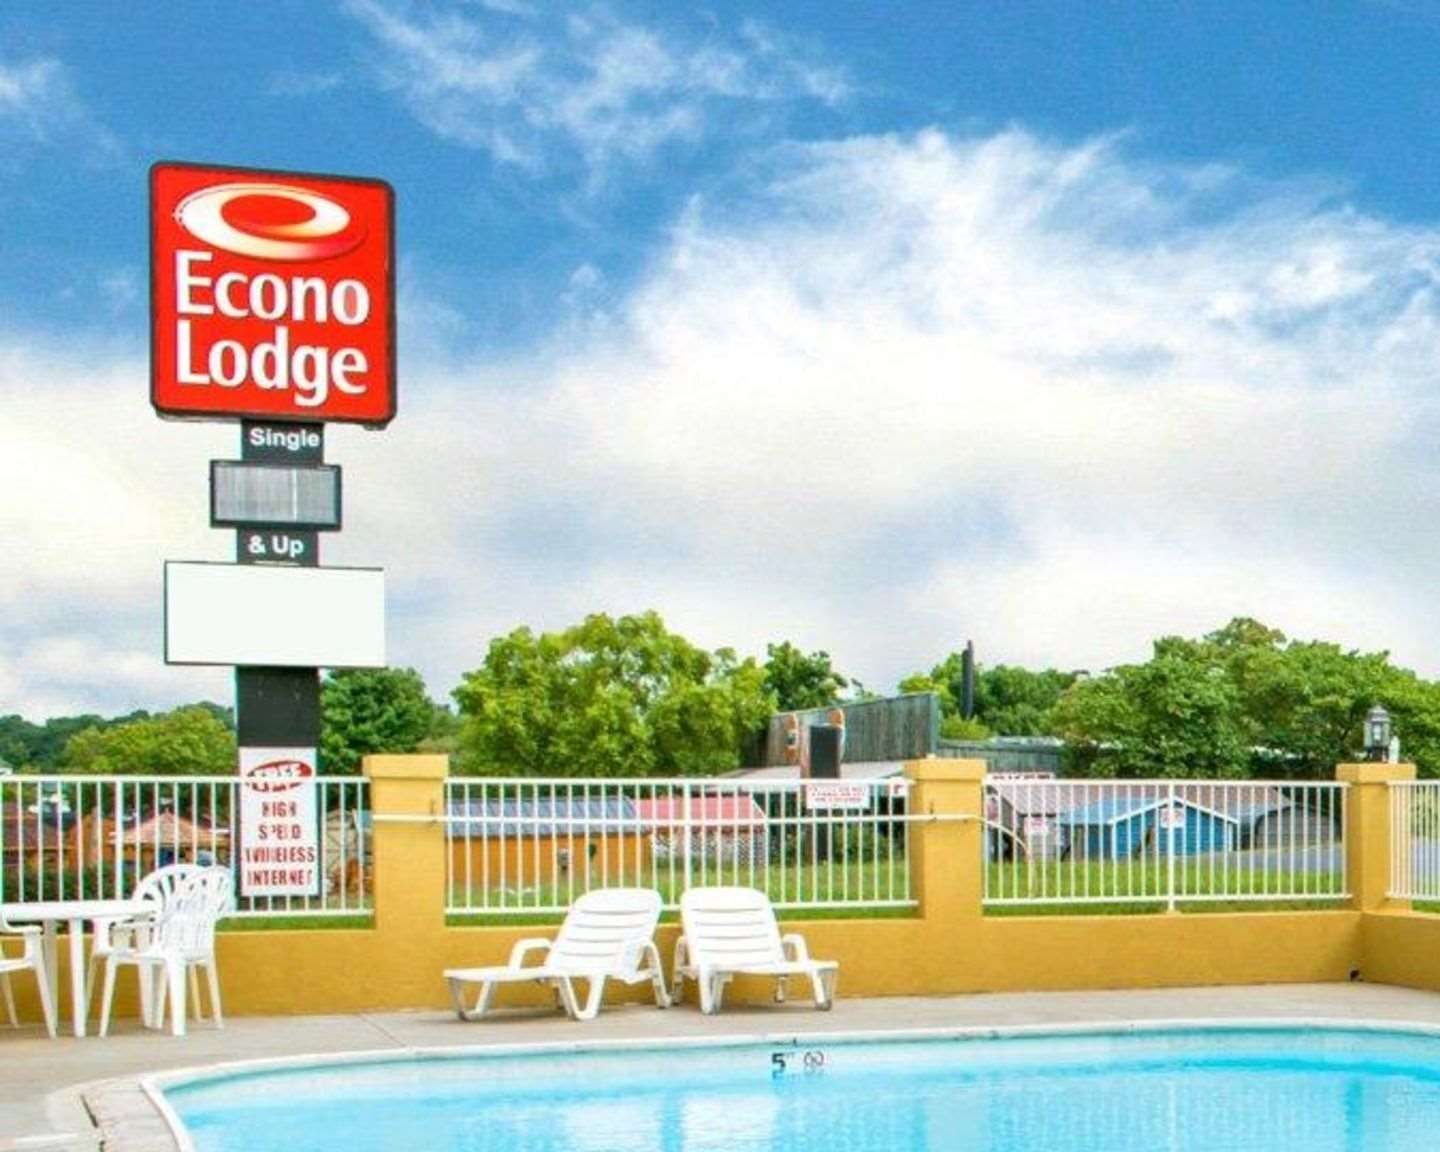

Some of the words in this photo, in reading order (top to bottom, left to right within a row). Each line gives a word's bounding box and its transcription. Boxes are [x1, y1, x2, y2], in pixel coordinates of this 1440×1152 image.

[175, 249, 370, 326] Econo
[176, 319, 369, 407] Lodge
[250, 428, 321, 450] Single
[248, 535, 266, 554] &
[272, 535, 304, 558] Up
[262, 801, 297, 817] HIGH
[245, 847, 315, 863] WIRELESS
[248, 870, 313, 886] INTERNET
[771, 1052, 786, 1068] 5
